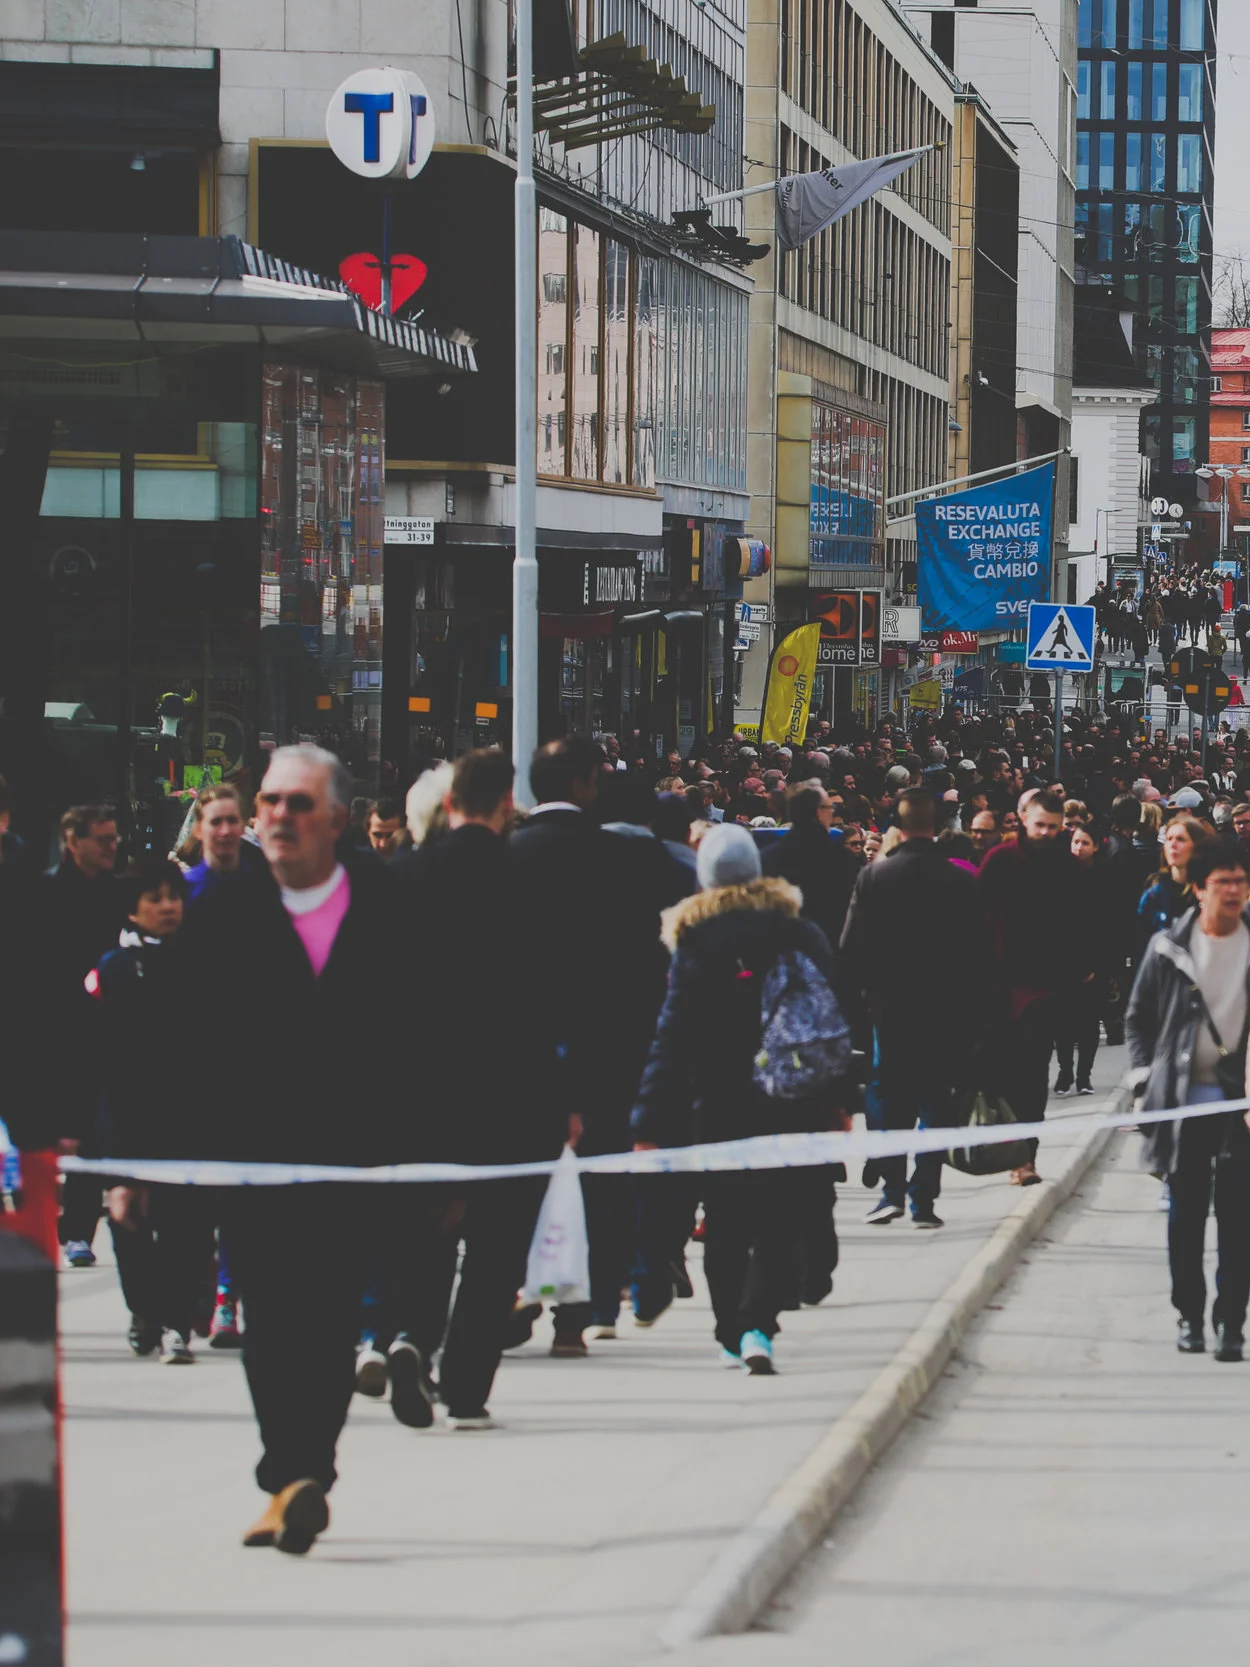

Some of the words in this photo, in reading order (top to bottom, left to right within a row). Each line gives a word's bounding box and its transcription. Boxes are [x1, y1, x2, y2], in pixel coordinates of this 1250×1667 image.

[344, 92, 394, 163] T
[935, 502, 1041, 521] RESEVALUTA
[407, 533, 431, 541] 31-39
[948, 522, 1040, 540] EXCHANGE
[974, 561, 1038, 579] CAMBIO
